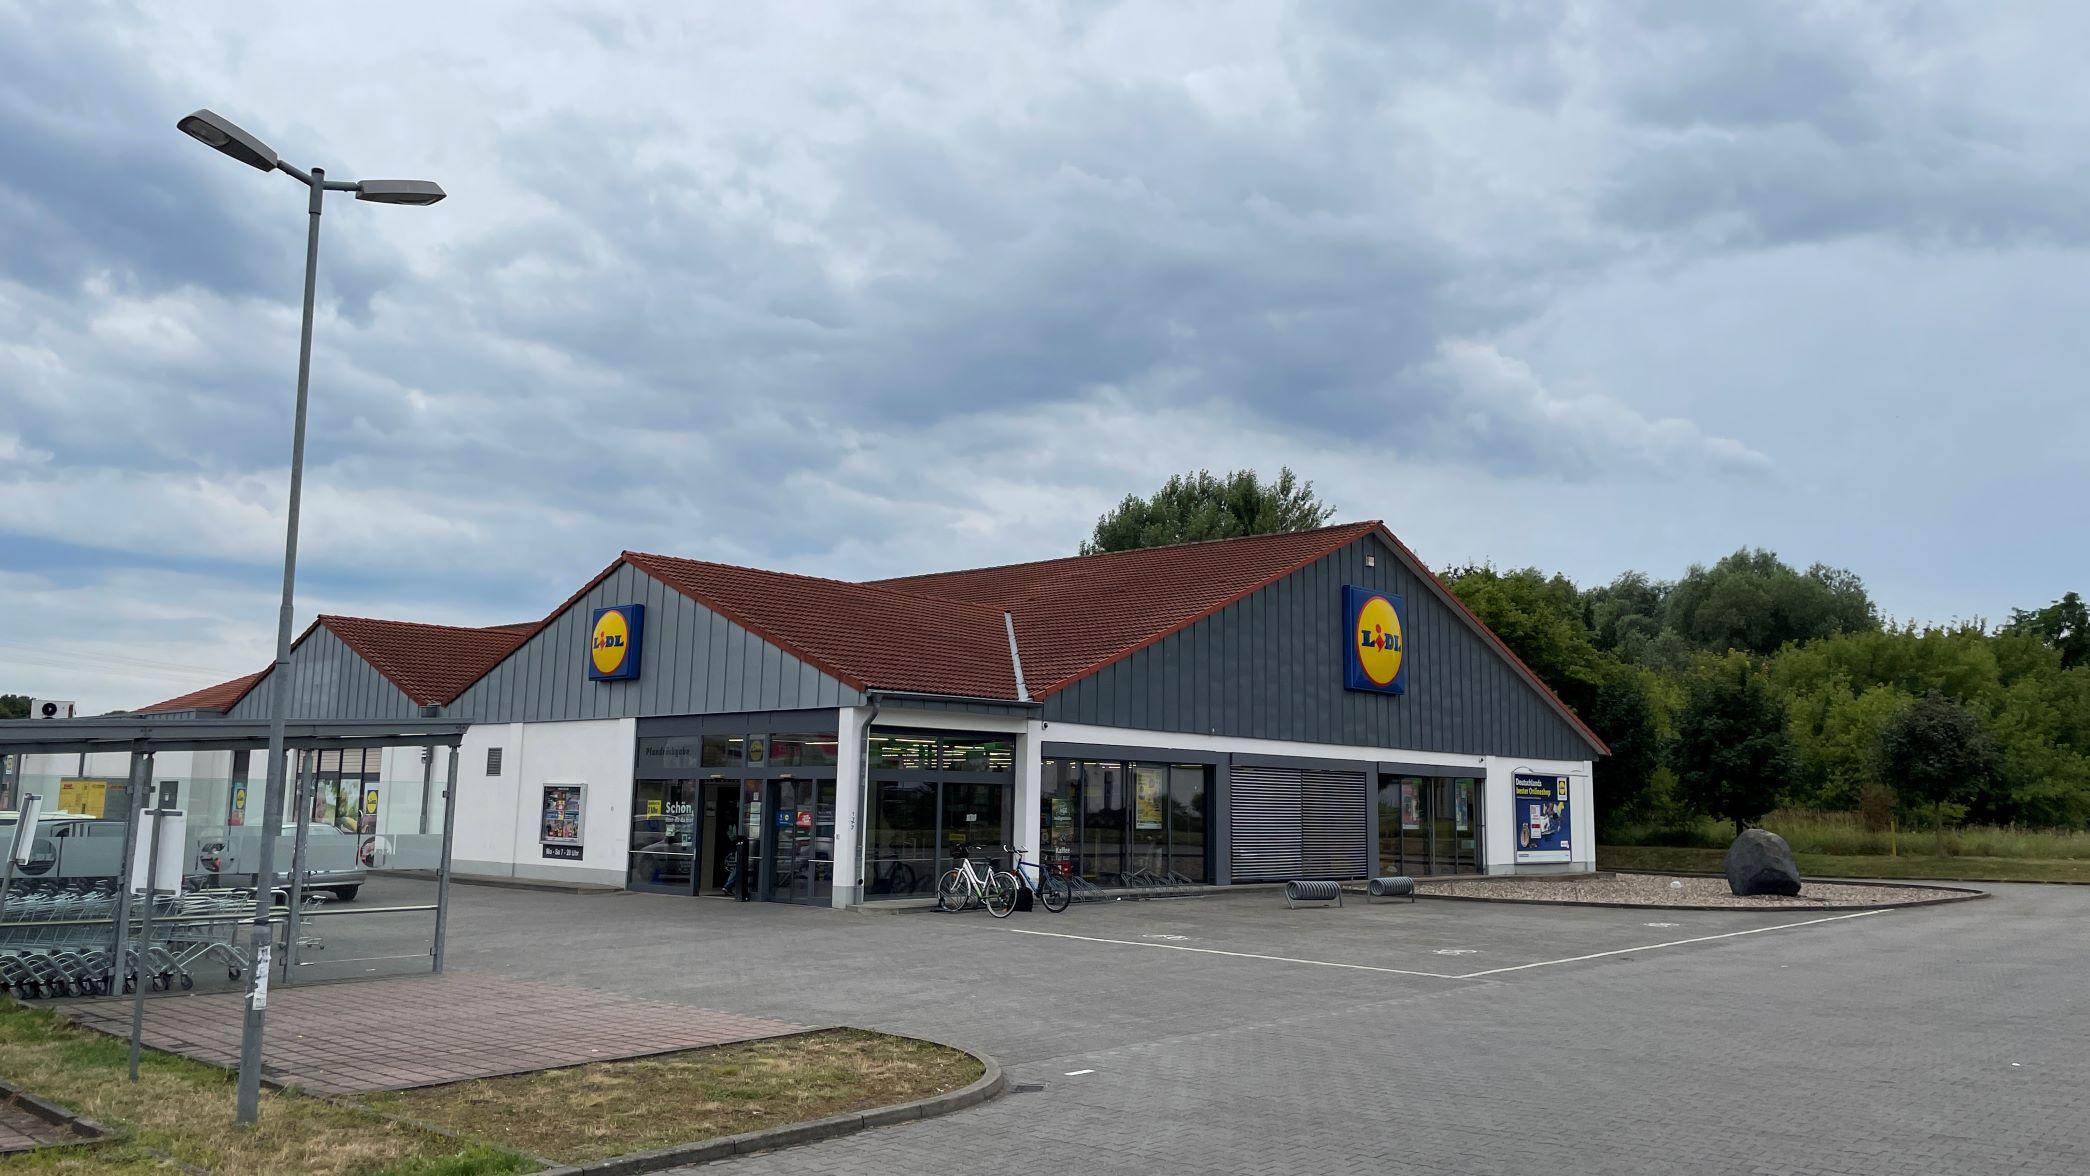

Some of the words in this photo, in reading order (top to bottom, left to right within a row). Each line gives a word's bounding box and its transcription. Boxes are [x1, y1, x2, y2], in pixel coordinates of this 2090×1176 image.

[1515, 778, 1542, 787] Deutschlands
[1529, 787, 1551, 797] Onlineshop
[1055, 846, 1071, 854] Kaffee
